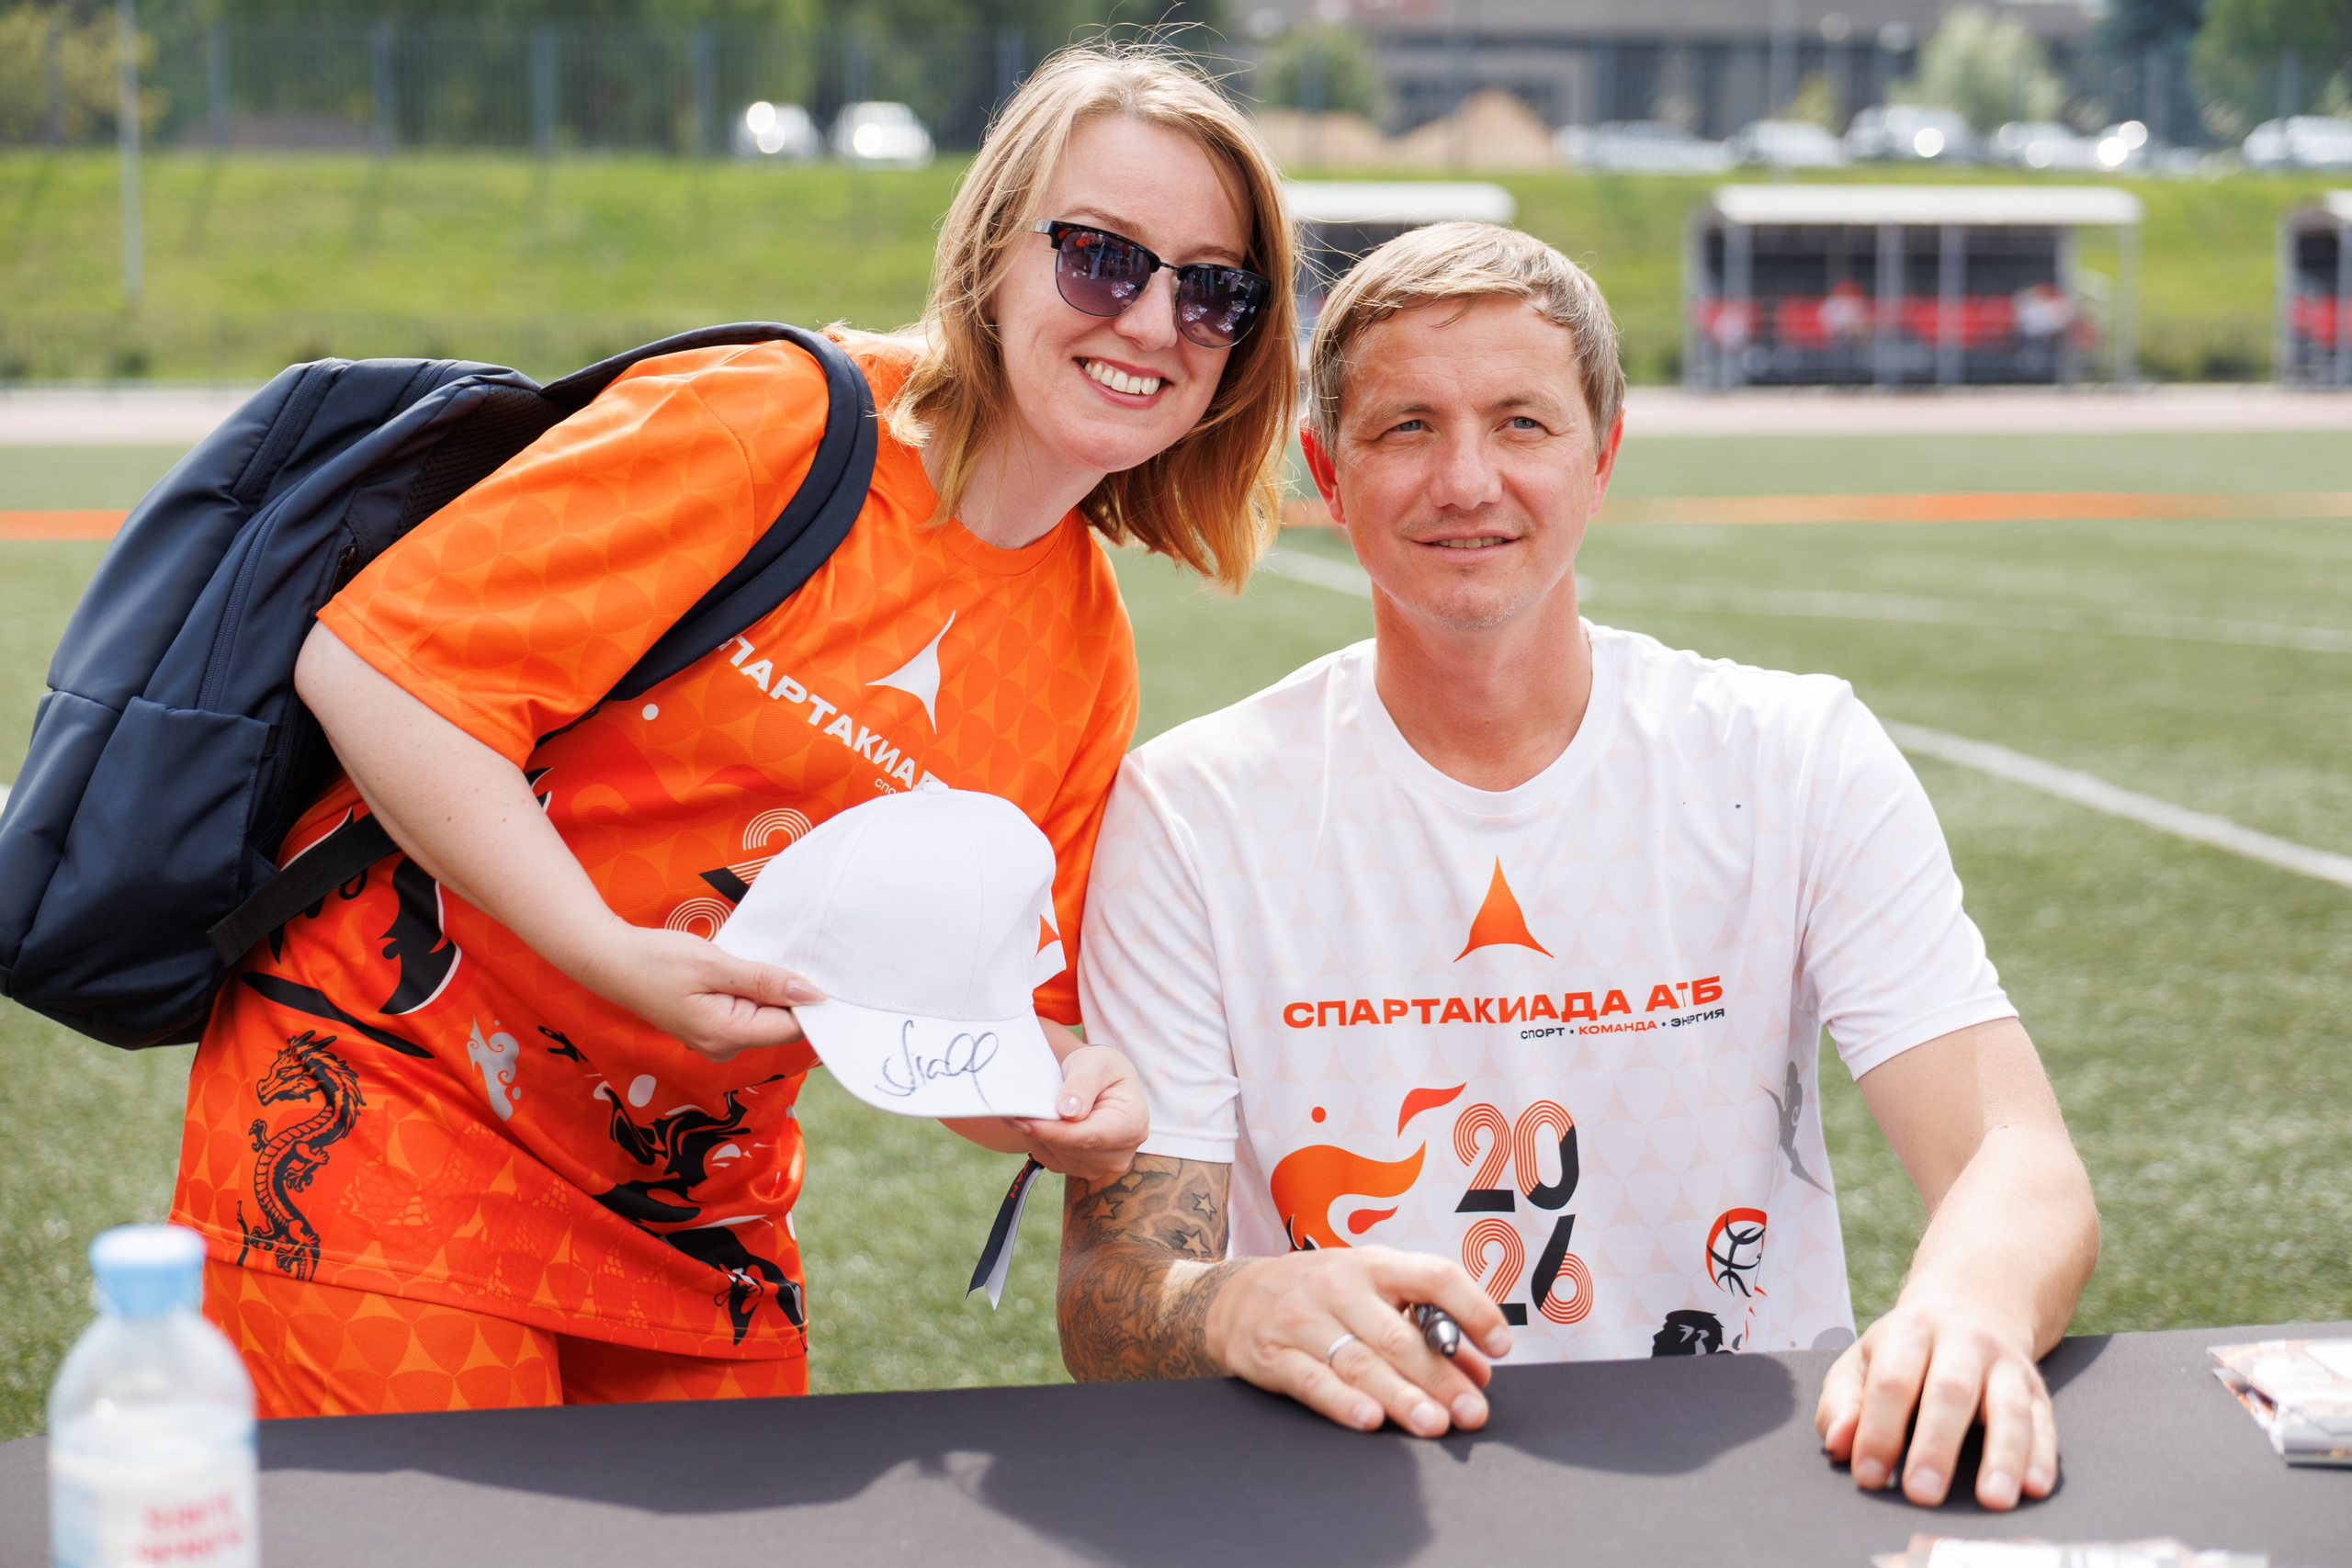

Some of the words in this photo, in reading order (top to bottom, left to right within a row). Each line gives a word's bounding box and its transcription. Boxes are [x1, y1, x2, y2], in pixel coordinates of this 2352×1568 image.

[1283, 989, 1632, 1028] СПАРТАКИАДА
[1645, 976, 1723, 1012] АТБ
[1521, 1027, 1565, 1040] СПОРТ
[1578, 1020, 1657, 1035] КОМАНДА
[1670, 1008, 1725, 1028] ЭНРГИЯ
[1453, 1100, 1579, 1213] 20
[1462, 1213, 1594, 1325] 26
